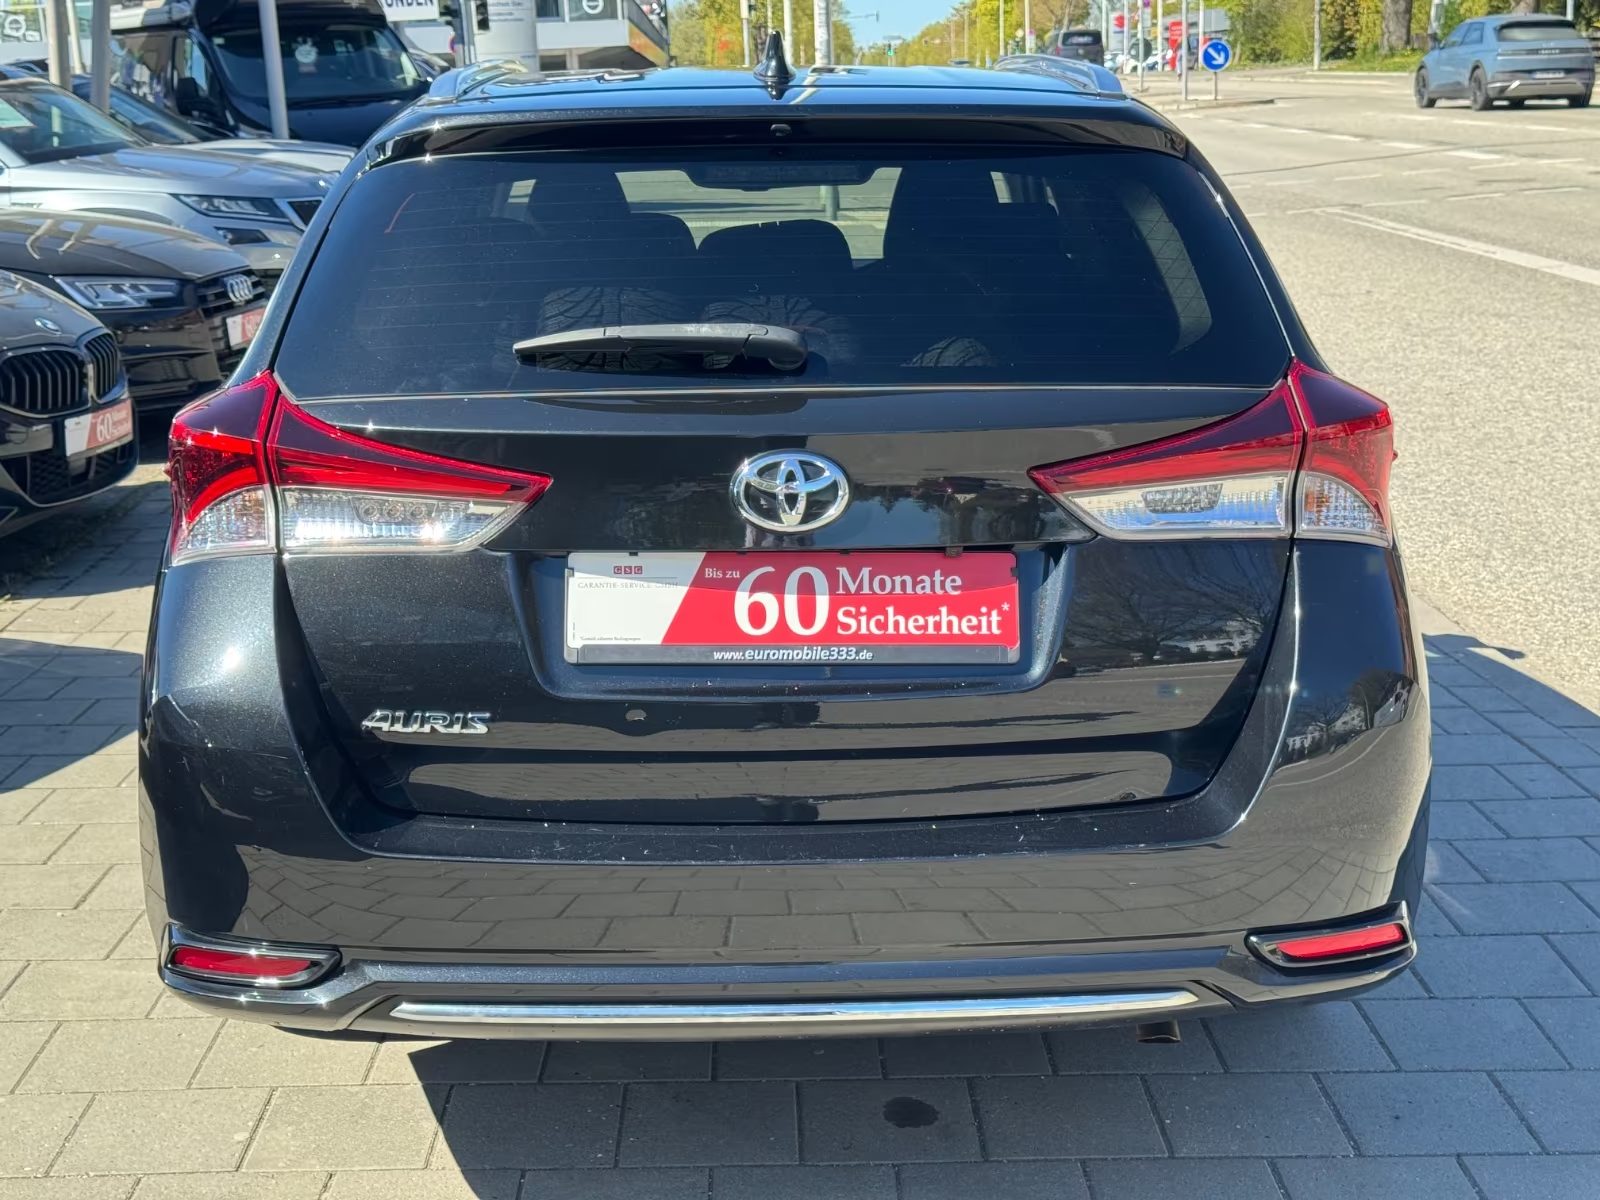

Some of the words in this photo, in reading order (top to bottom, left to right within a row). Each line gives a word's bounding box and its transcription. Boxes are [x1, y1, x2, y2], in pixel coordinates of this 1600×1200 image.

[704, 567, 723, 578] Bis
[836, 567, 962, 595] Monate
[734, 566, 830, 636] 60
[713, 646, 874, 661] www.euromobile333.de
[361, 709, 491, 734] AURIS
